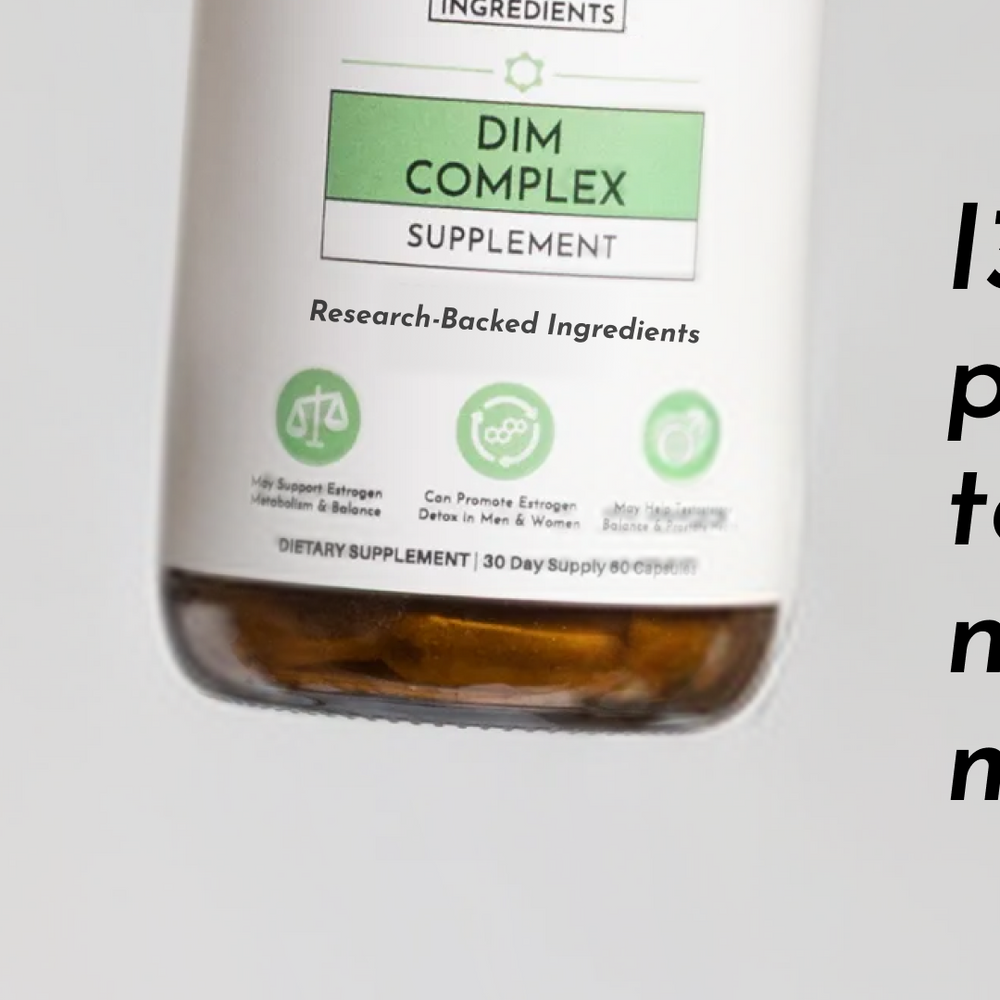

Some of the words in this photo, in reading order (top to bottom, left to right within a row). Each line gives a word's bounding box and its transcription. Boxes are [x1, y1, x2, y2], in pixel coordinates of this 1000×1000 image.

[478, 114, 561, 154] DIM
[406, 159, 627, 207] COMPLEX
[406, 223, 618, 260] SUPPLEMENT
[309, 298, 540, 334] Research-Backed
[547, 312, 700, 344] Ingredients
[277, 476, 323, 494] Support
[327, 482, 383, 500] Estrogen
[424, 489, 452, 504] Can
[457, 491, 513, 508] Promote
[519, 495, 577, 513] Estrogen
[331, 500, 382, 517] Balance
[418, 507, 458, 523] Detox
[480, 512, 510, 526] Men
[531, 514, 581, 529] Women
[278, 537, 346, 559] DIETARY
[349, 544, 471, 568] SUPPLEMENT
[483, 553, 506, 570] 30
[510, 555, 543, 575] Day
[547, 557, 606, 577] Supply
